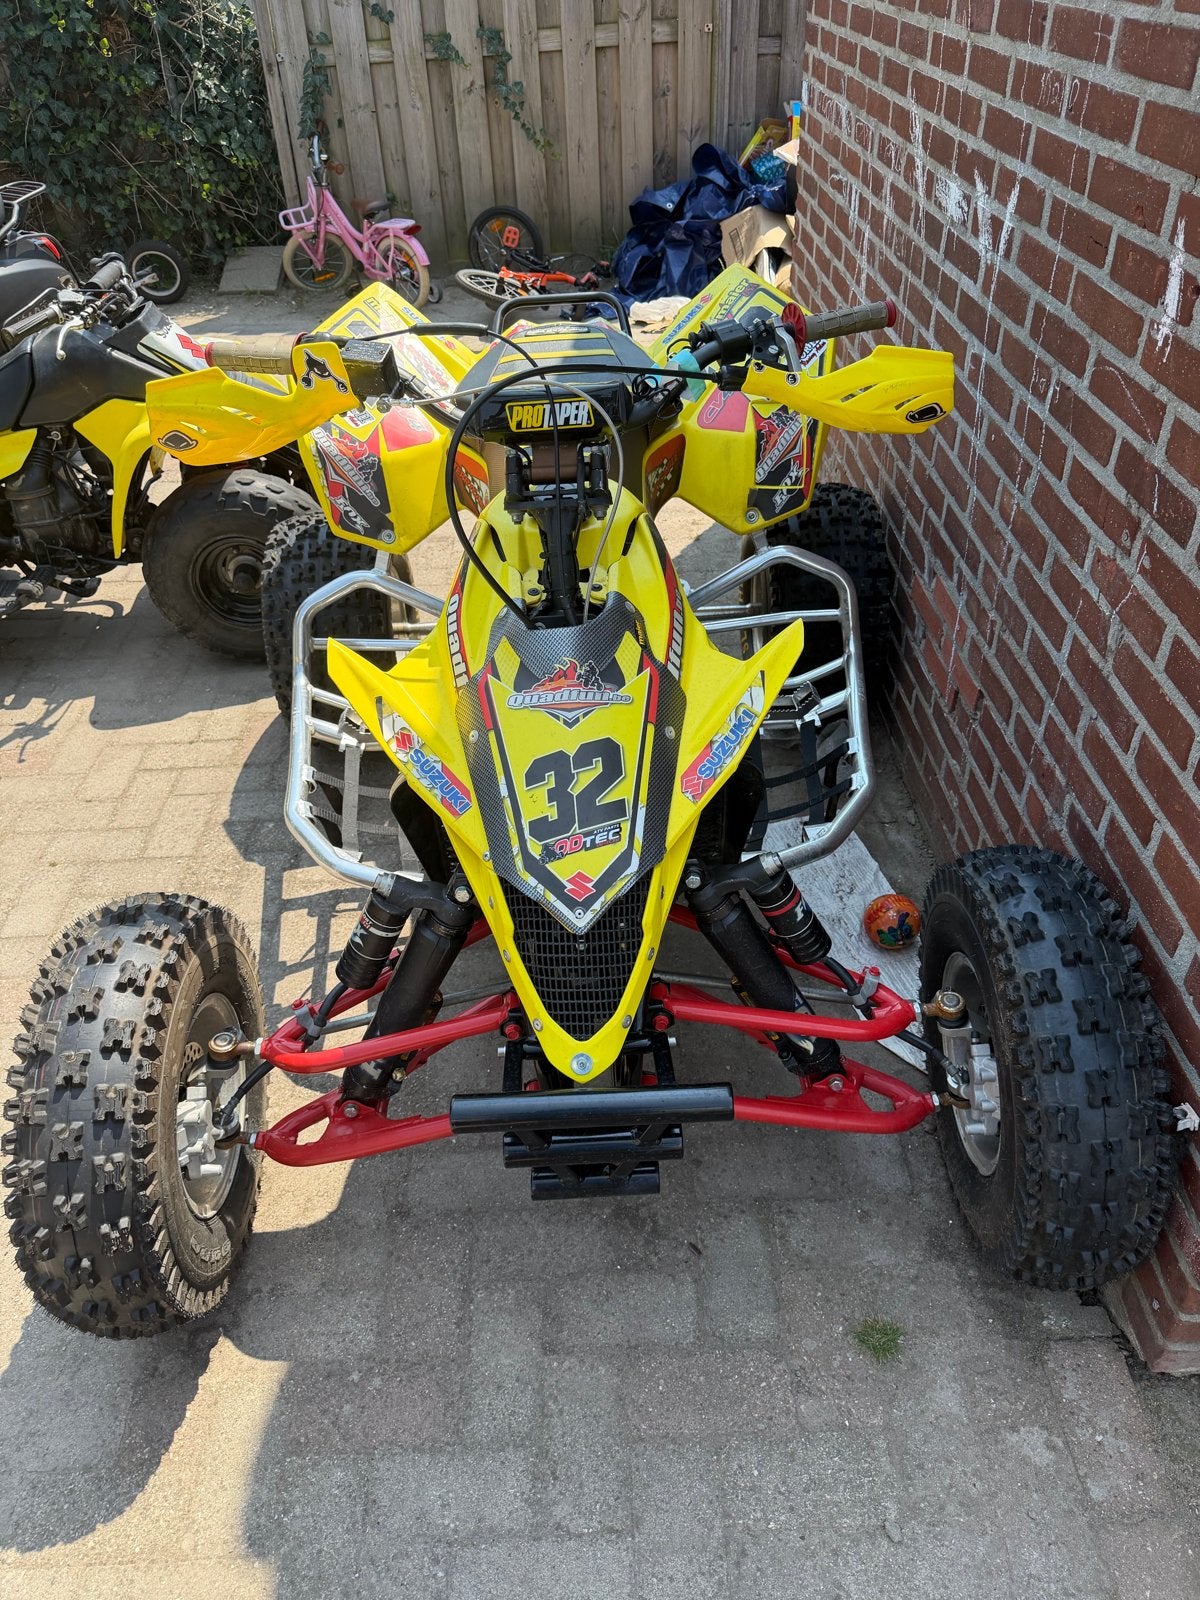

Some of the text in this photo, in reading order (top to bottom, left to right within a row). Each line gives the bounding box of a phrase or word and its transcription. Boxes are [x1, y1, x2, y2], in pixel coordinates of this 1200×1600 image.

[662, 303, 703, 345] SUZUKI
[511, 402, 589, 429] PROTAPER
[331, 497, 370, 535] FOX
[697, 709, 755, 780] SUZUKI
[409, 747, 472, 815] SUZUKI
[524, 736, 629, 844] 32
